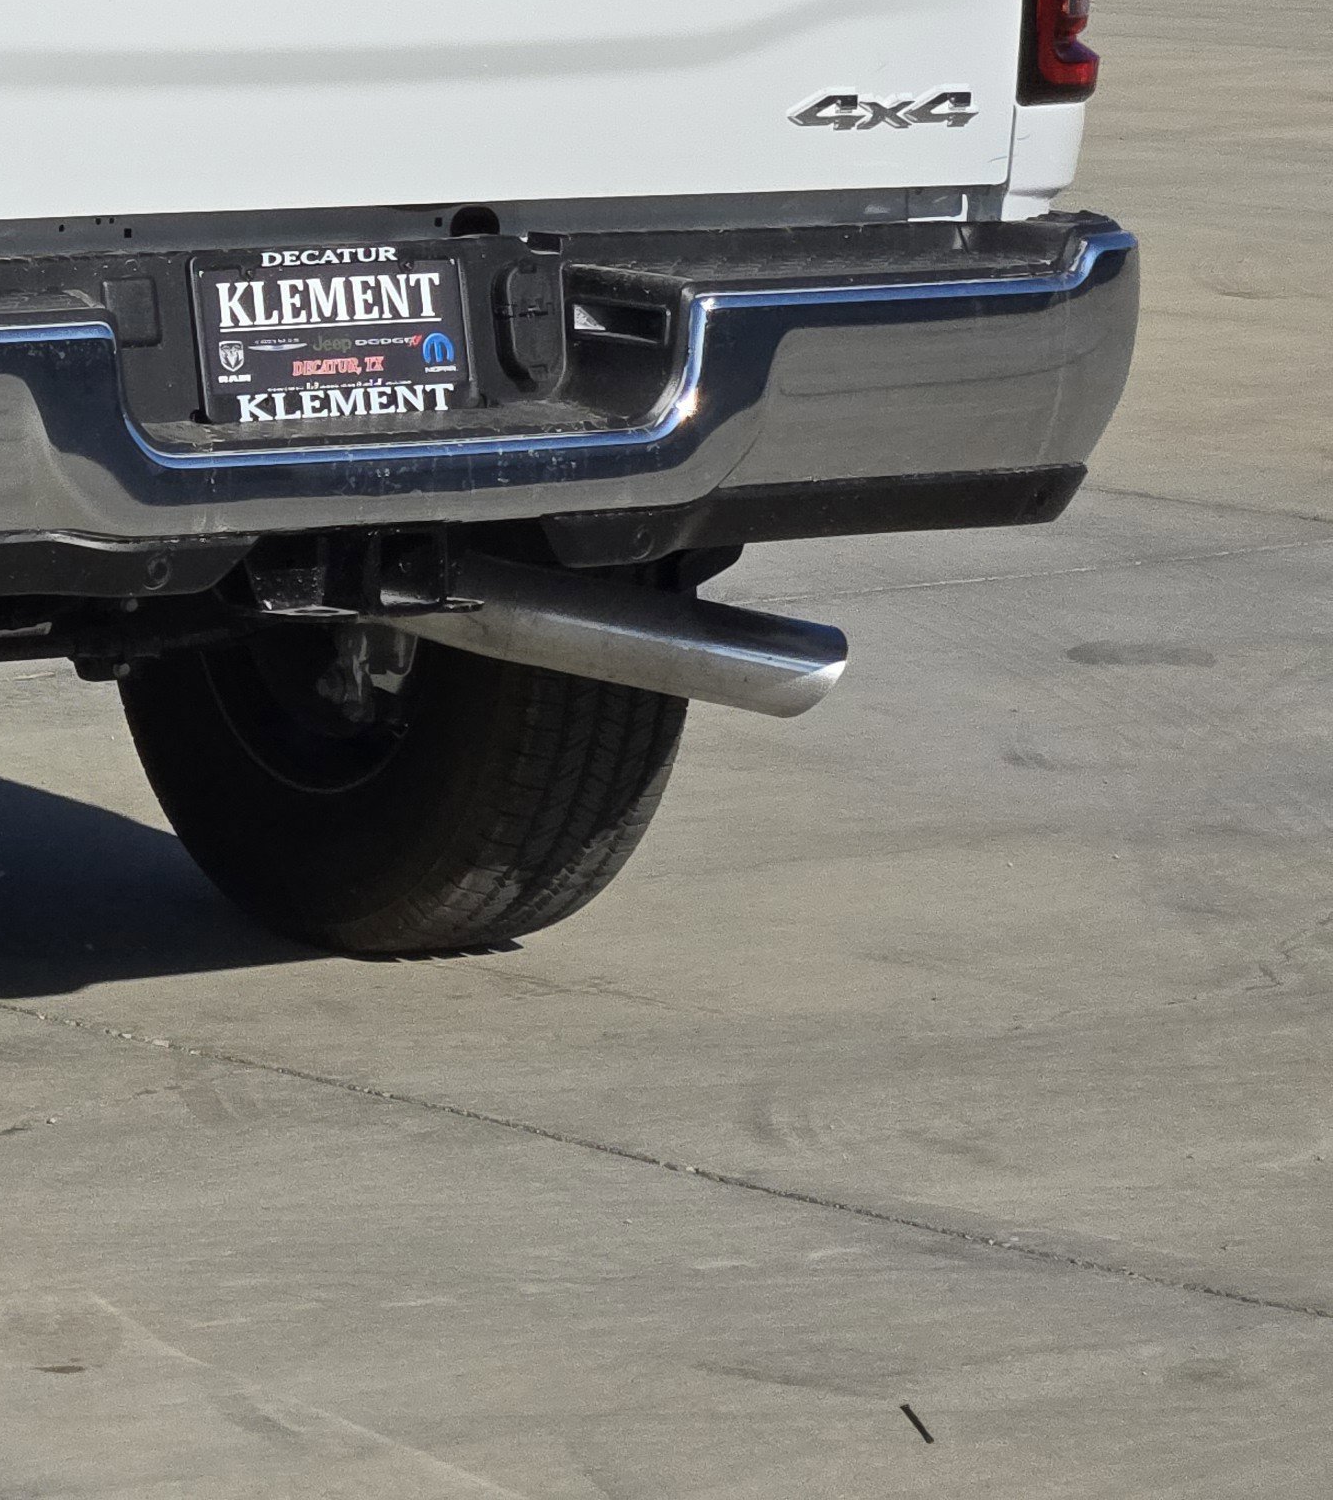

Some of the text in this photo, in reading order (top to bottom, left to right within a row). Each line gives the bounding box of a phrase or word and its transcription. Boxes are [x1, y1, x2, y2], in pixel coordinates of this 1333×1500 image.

[786, 85, 979, 131] 4x4
[261, 246, 398, 268] DECATUR
[215, 272, 441, 328] KLEMENT
[313, 335, 352, 353] Jeep
[292, 355, 384, 376] DECATUR, TX
[218, 374, 252, 384] RAM
[237, 383, 454, 423] KLEMENT
